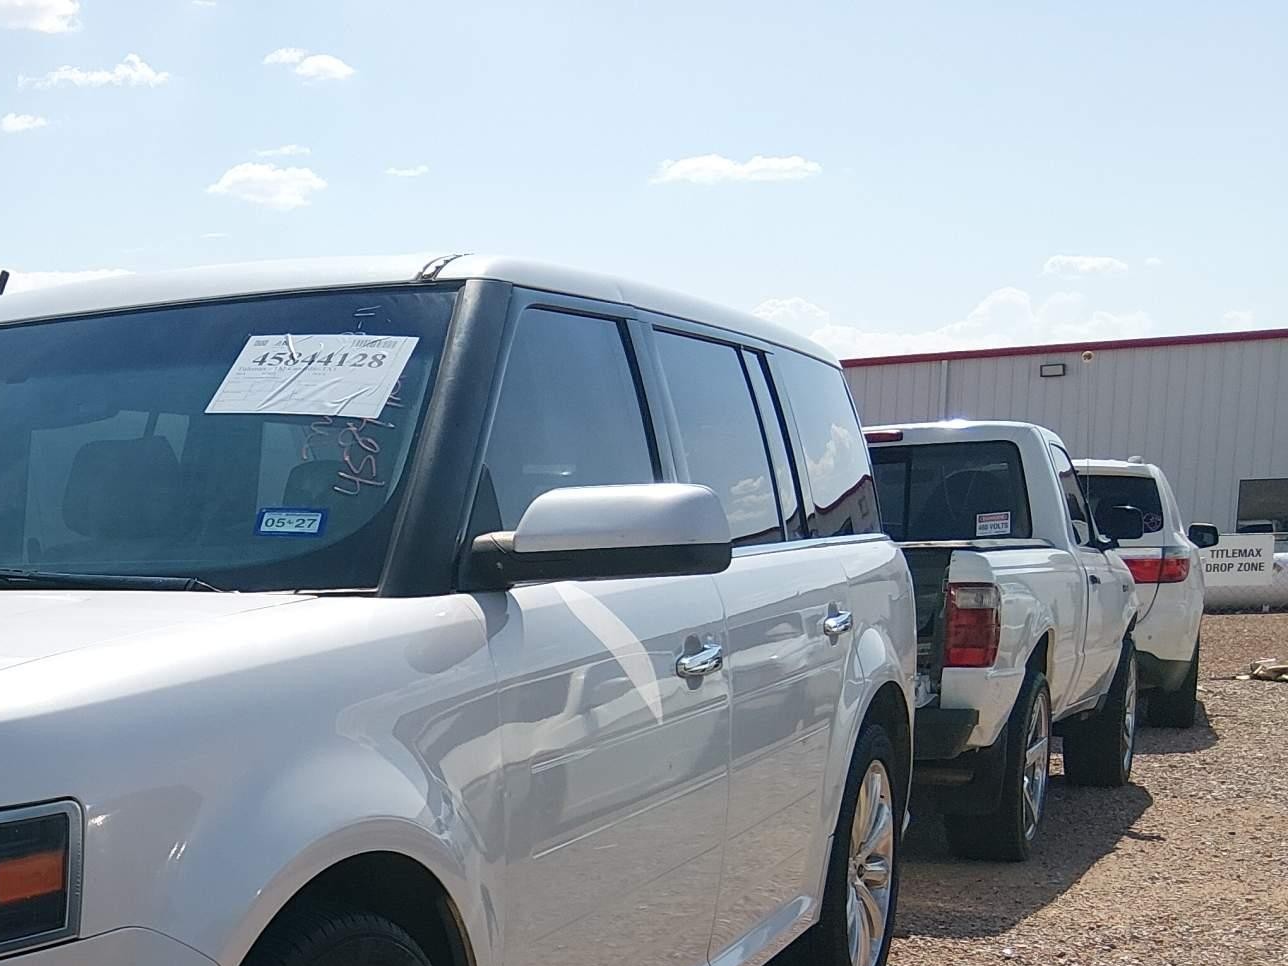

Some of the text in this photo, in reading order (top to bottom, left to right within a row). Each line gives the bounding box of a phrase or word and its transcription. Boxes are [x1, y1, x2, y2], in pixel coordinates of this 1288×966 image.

[252, 351, 387, 369] 45844128
[1209, 548, 1263, 559] TITLEMAX
[1205, 561, 1265, 573] DROP ZONE
